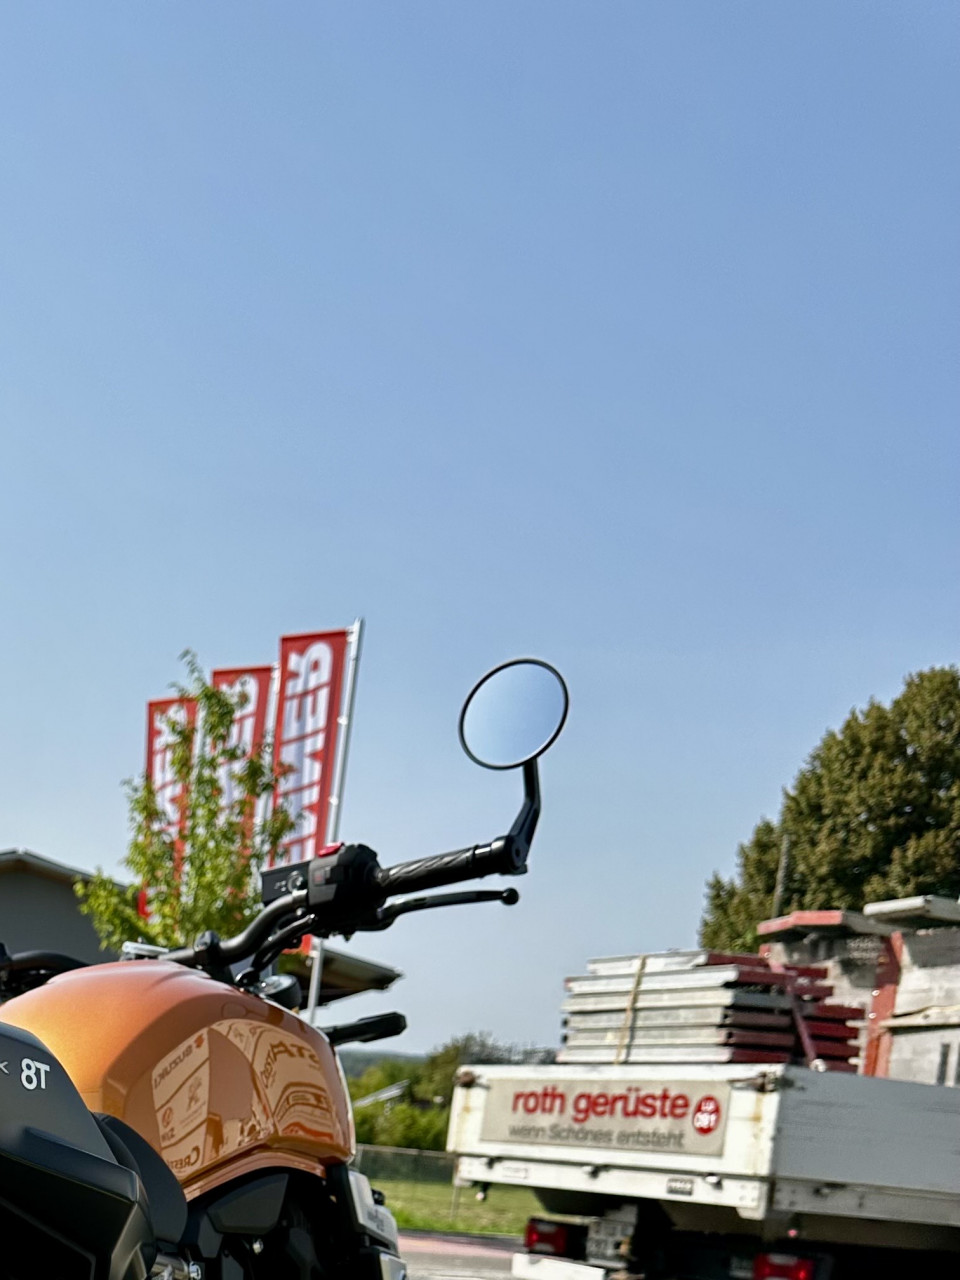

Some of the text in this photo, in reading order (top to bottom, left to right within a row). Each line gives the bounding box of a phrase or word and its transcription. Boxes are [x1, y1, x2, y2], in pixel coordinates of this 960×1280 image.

[20, 1057, 51, 1091] 8T
[512, 1084, 691, 1124] roth gerüste
[507, 1123, 686, 1150] wenn Schönes entsteht
